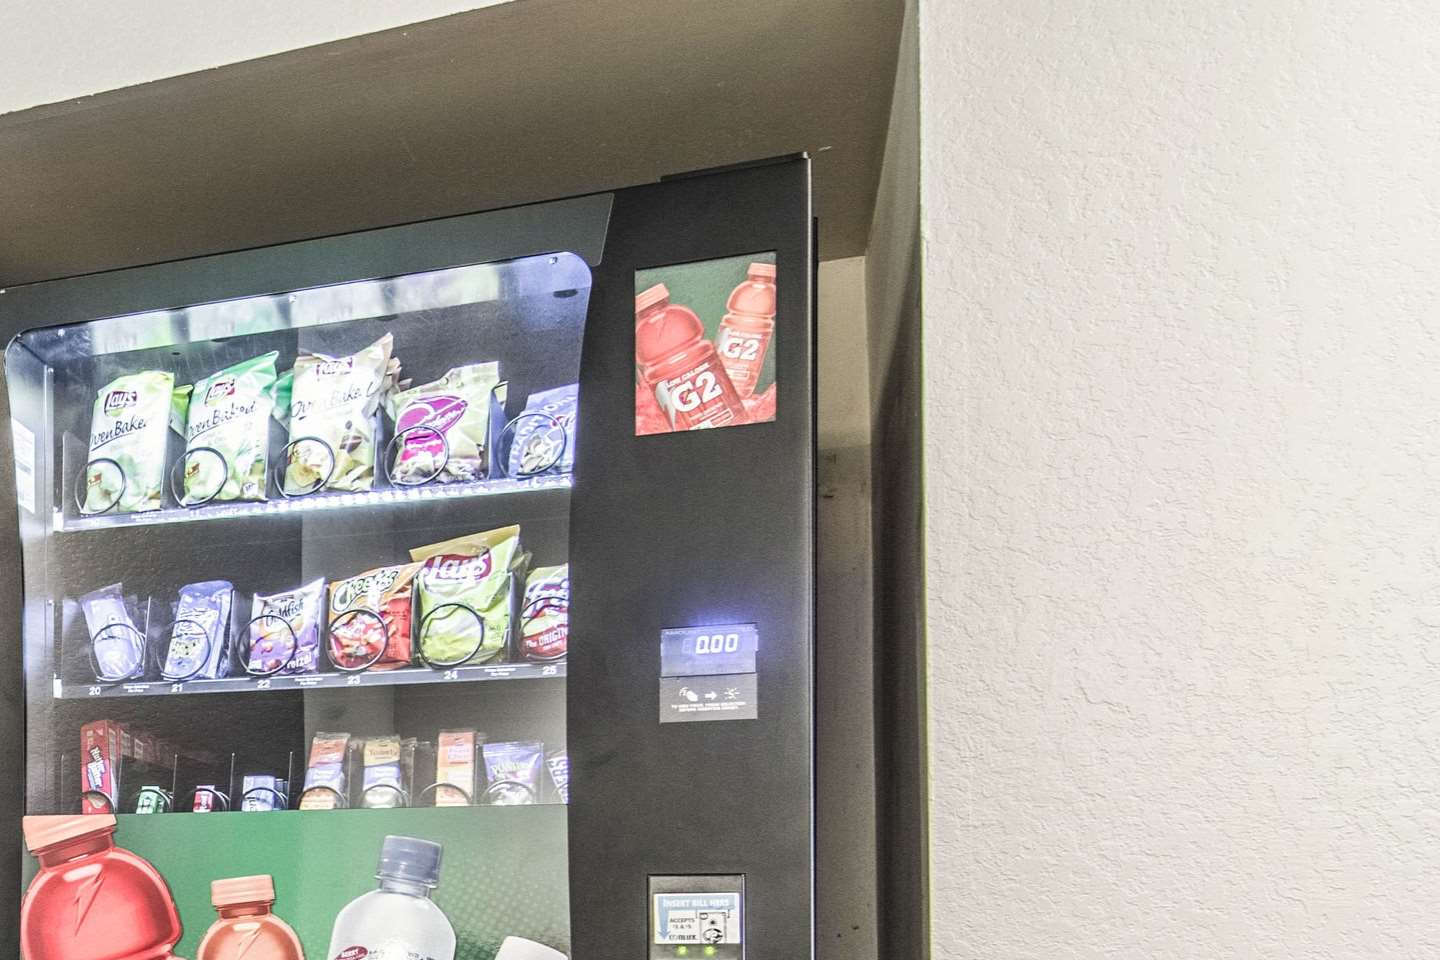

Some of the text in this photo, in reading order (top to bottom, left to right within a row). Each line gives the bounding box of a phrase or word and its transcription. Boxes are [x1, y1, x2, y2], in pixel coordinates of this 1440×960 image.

[723, 339, 759, 360] G2
[671, 371, 723, 412] G2
[347, 675, 360, 684] 23
[444, 671, 458, 680] 24
[171, 684, 182, 692] 21
[257, 680, 271, 689] 22
[88, 687, 100, 696] 20
